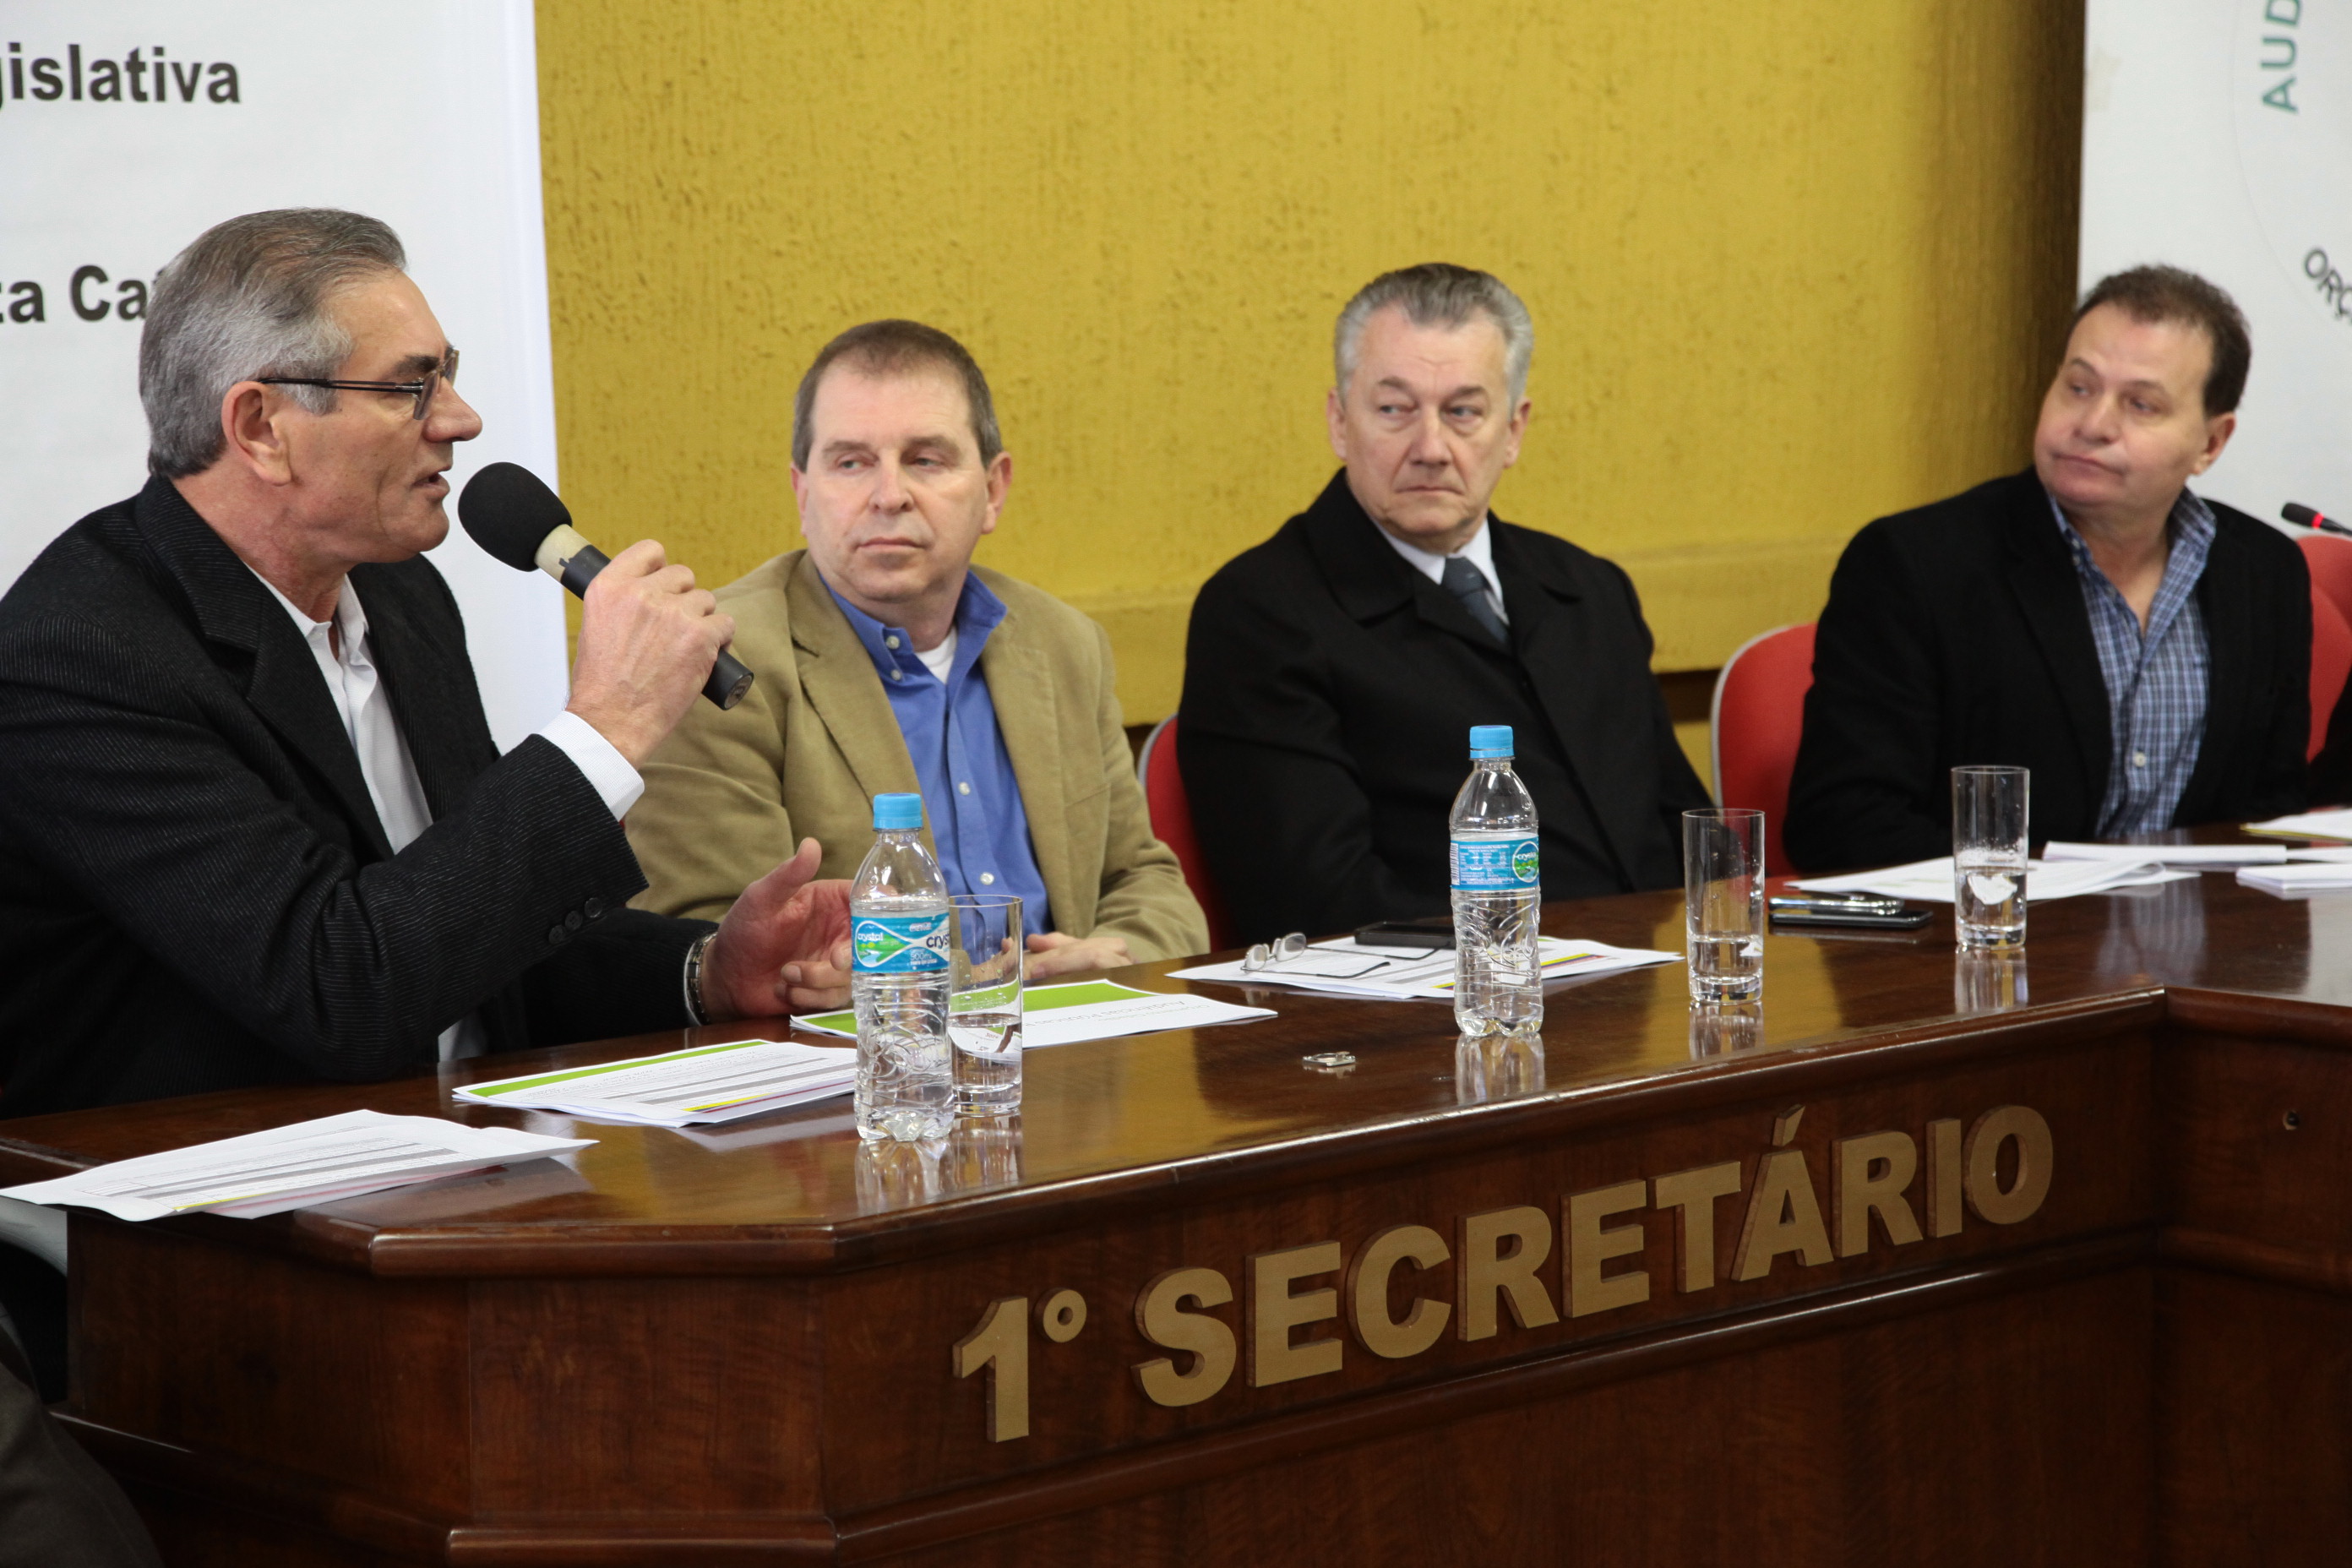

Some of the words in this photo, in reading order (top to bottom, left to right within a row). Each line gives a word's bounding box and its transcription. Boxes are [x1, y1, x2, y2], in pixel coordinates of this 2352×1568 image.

[0, 42, 240, 112] islativa
[0, 281, 45, 323] a
[70, 264, 161, 322] Ca
[1130, 1104, 2054, 1407] SECRETÁRIO
